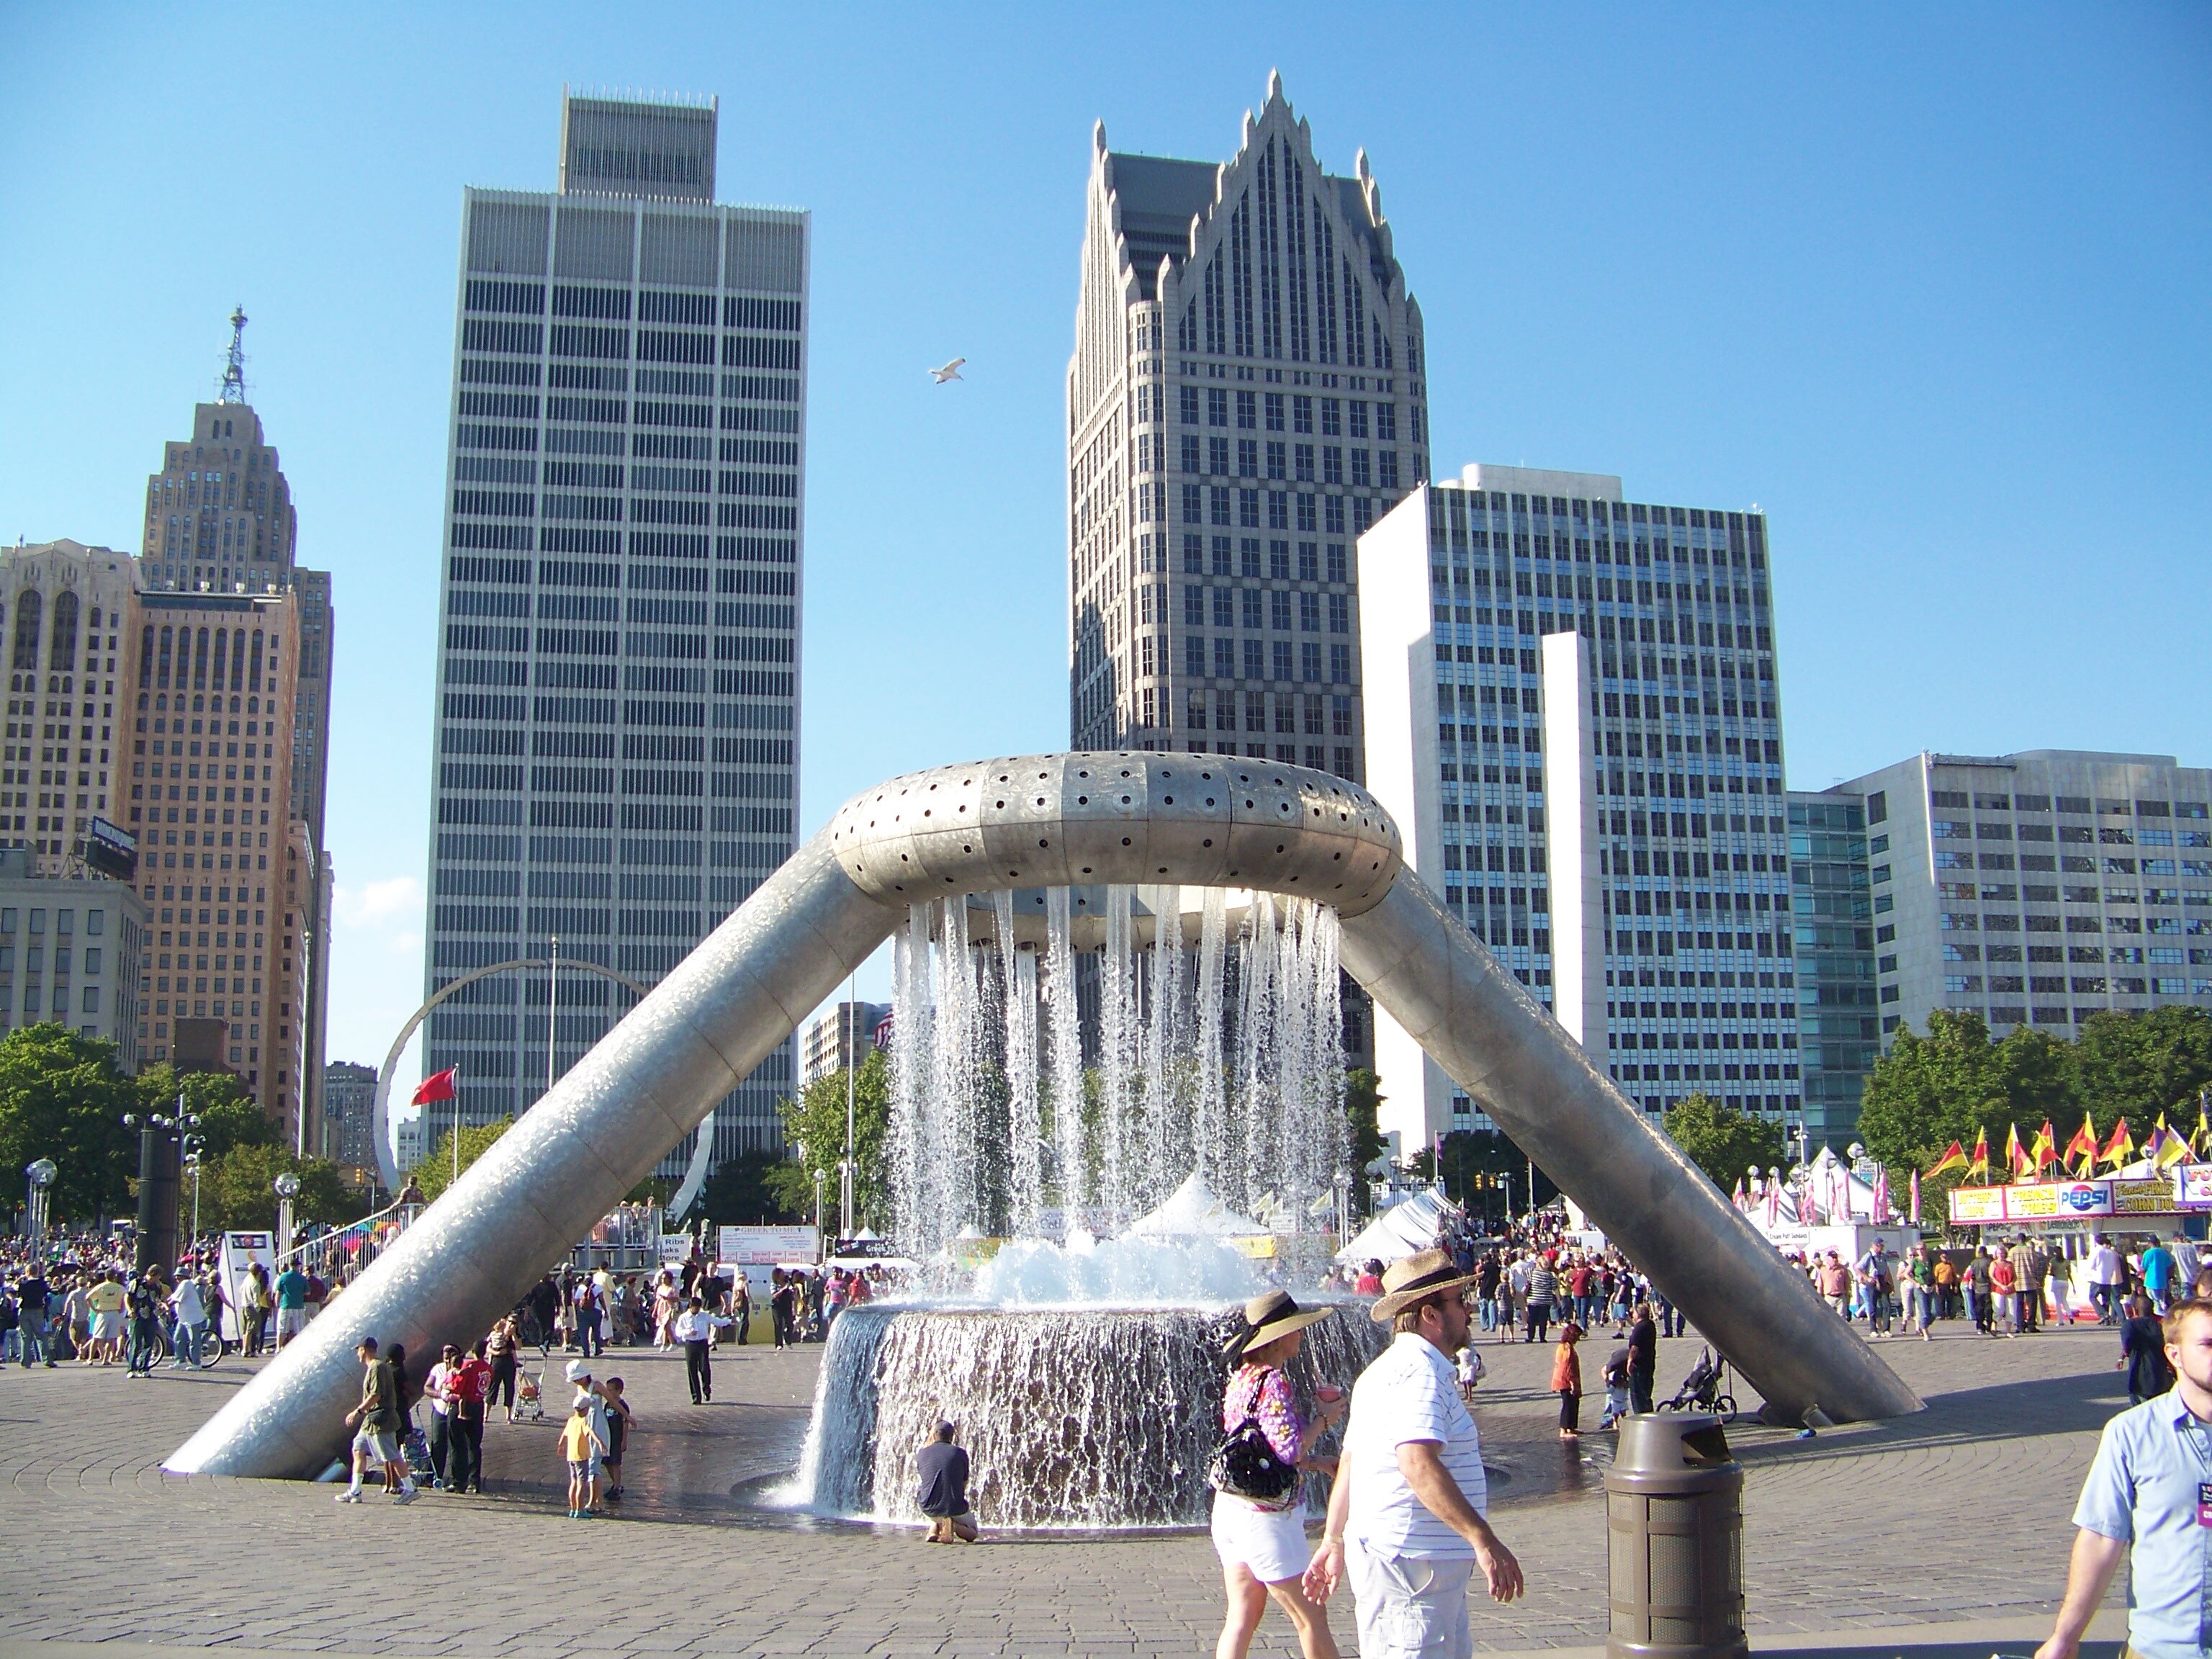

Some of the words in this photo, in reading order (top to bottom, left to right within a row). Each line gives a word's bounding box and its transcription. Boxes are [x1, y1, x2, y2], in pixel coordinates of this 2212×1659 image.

[2188, 1169, 2212, 1182] FU
[2062, 1190, 2108, 1205] PEPSI
[2124, 1197, 2154, 1211] CORN
